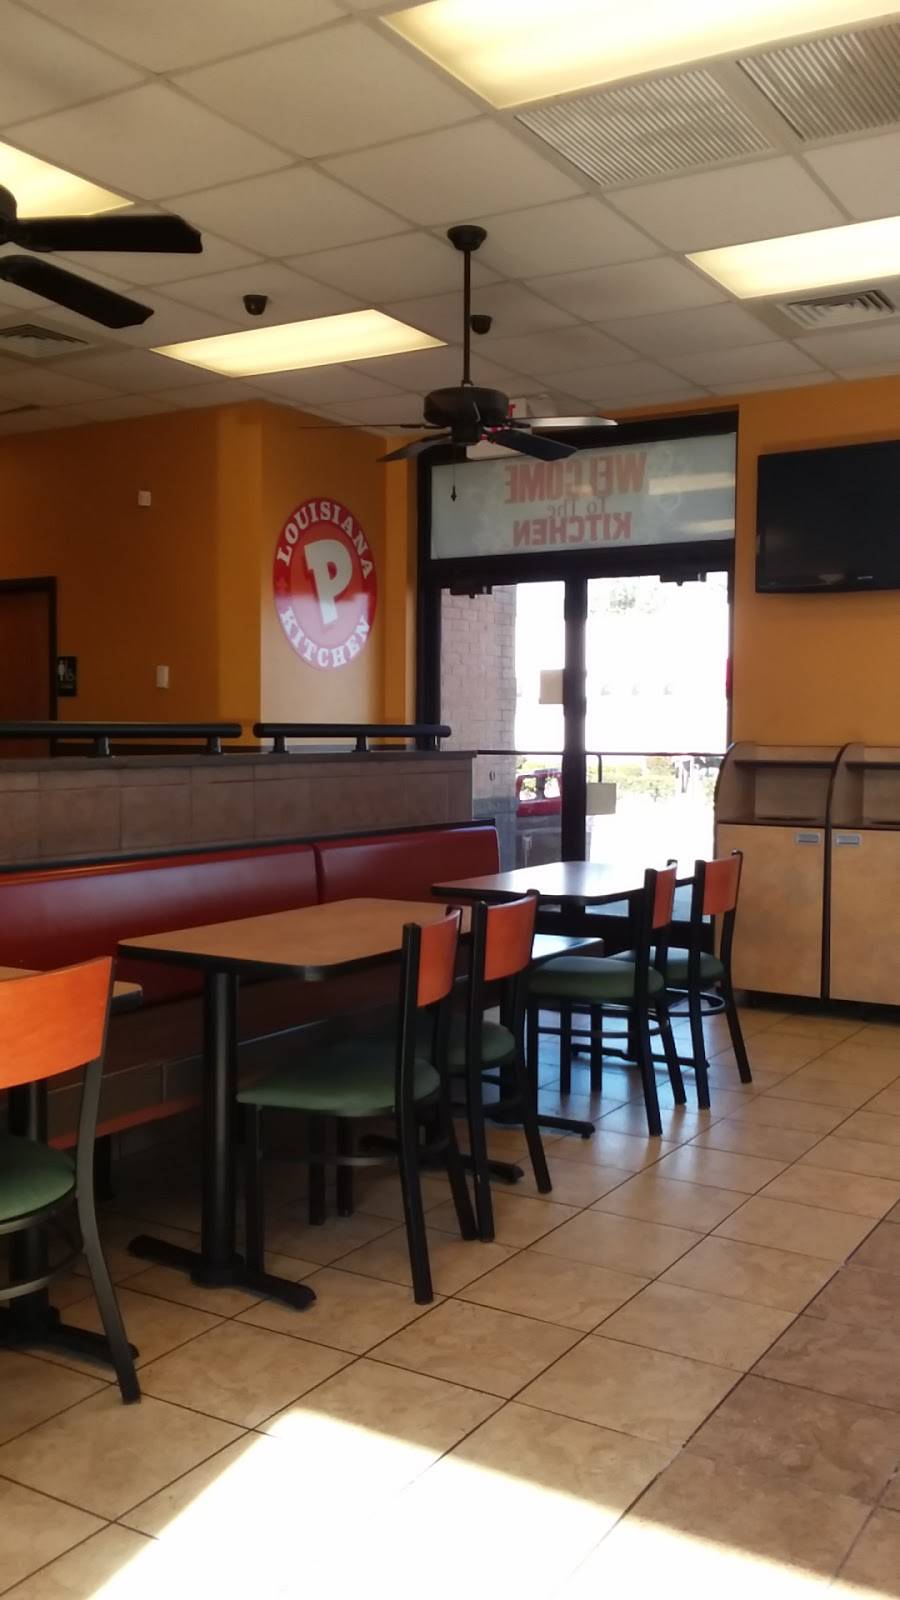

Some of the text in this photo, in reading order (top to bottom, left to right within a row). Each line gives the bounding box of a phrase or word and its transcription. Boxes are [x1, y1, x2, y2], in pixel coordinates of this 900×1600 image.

[277, 501, 373, 579] LOUISIANA
[304, 539, 353, 625] P
[280, 606, 370, 668] KITCHEN
